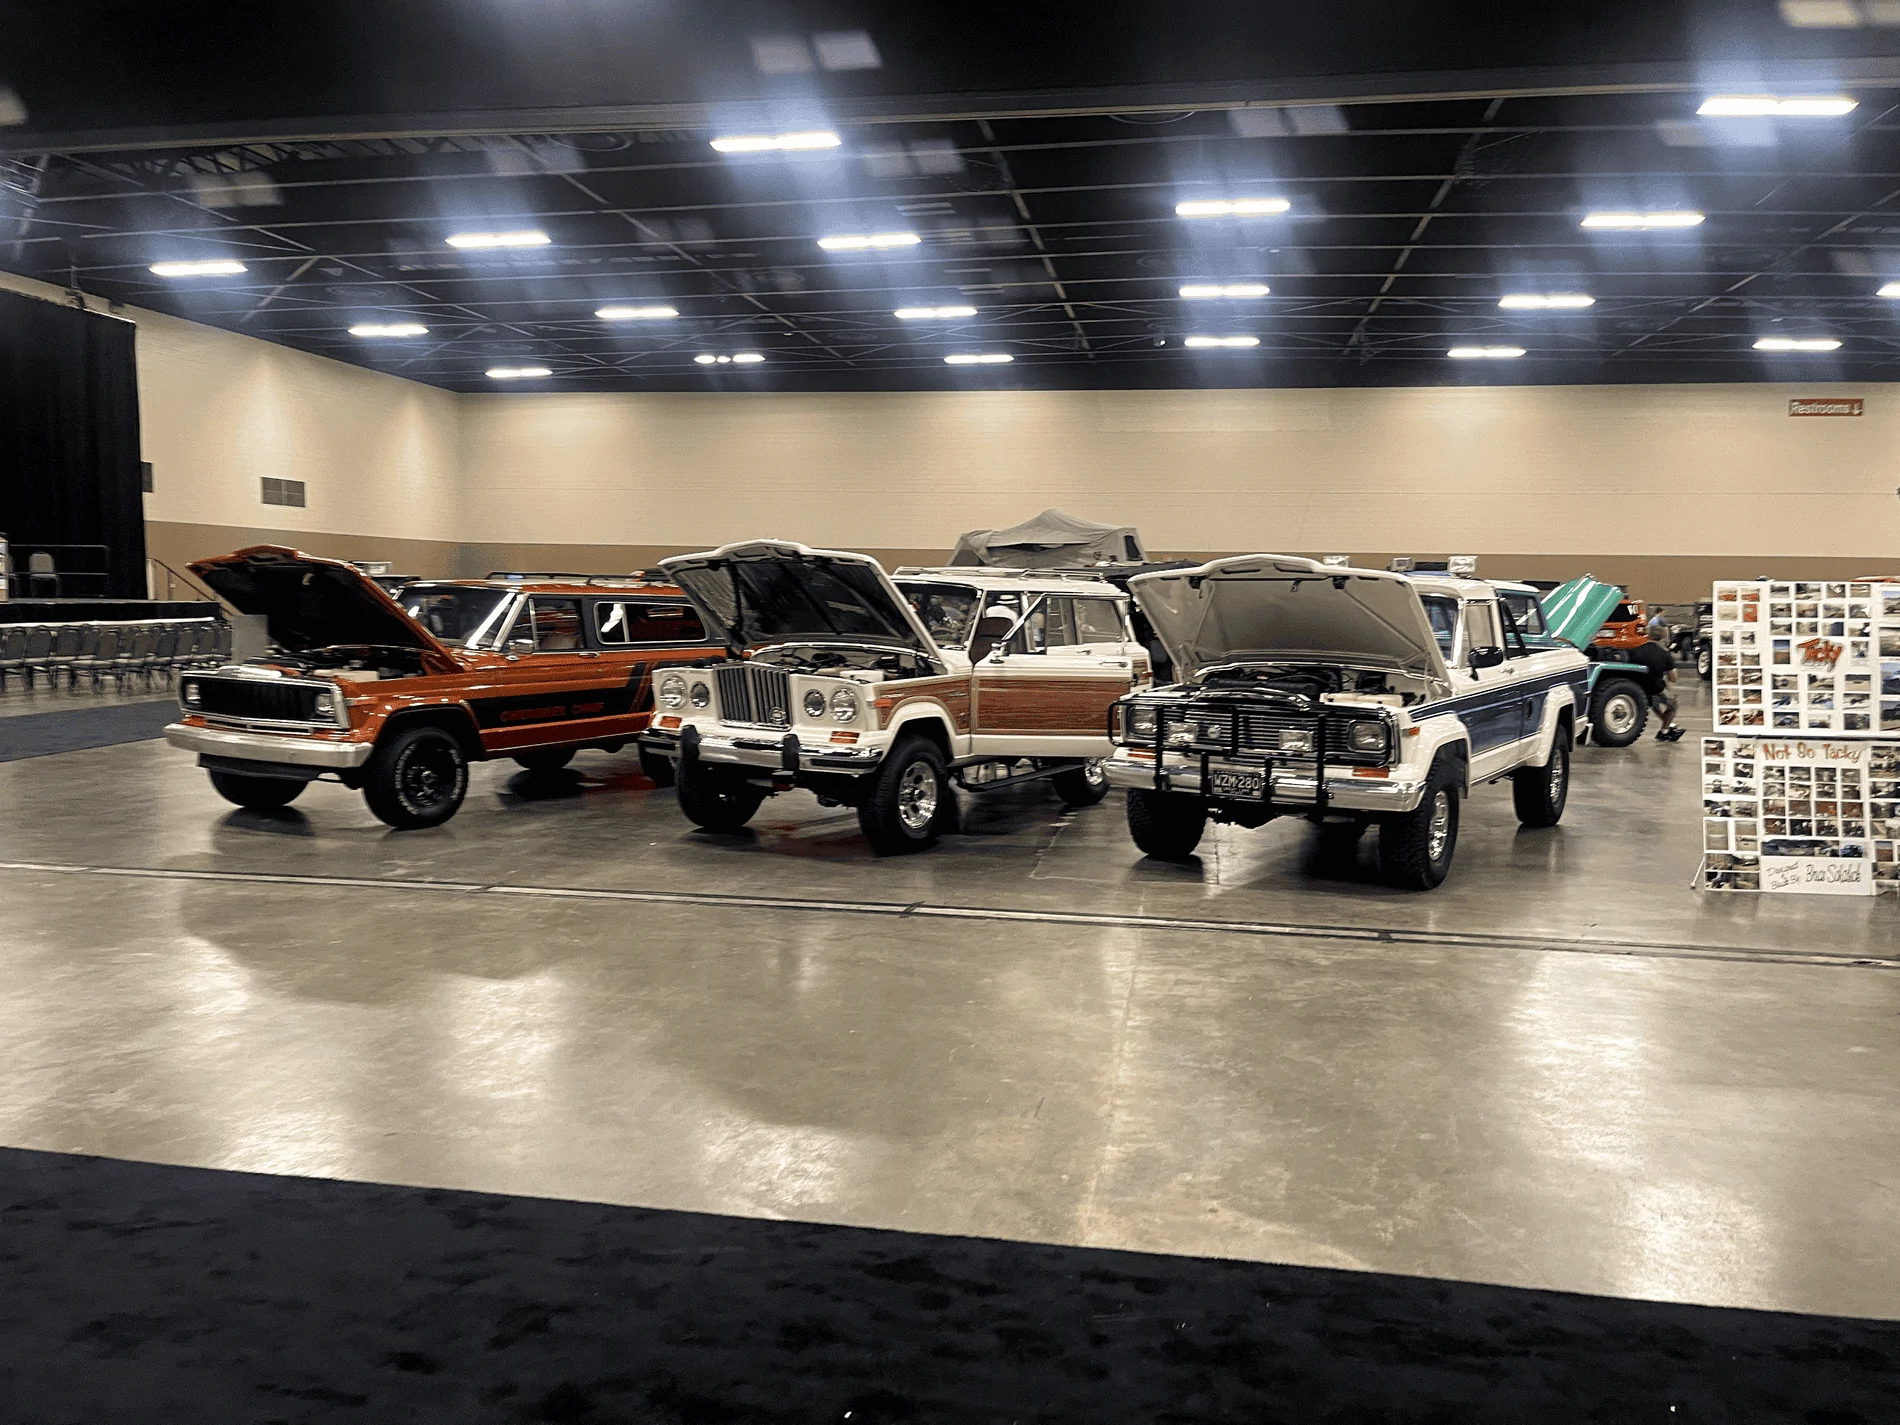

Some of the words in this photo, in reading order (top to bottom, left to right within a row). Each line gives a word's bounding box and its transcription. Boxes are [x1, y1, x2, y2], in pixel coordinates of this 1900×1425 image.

[1791, 401, 1851, 414] Restrooms
[1796, 638, 1842, 671] Tacky
[1763, 743, 1791, 760] Not
[1823, 743, 1862, 763] Tacky
